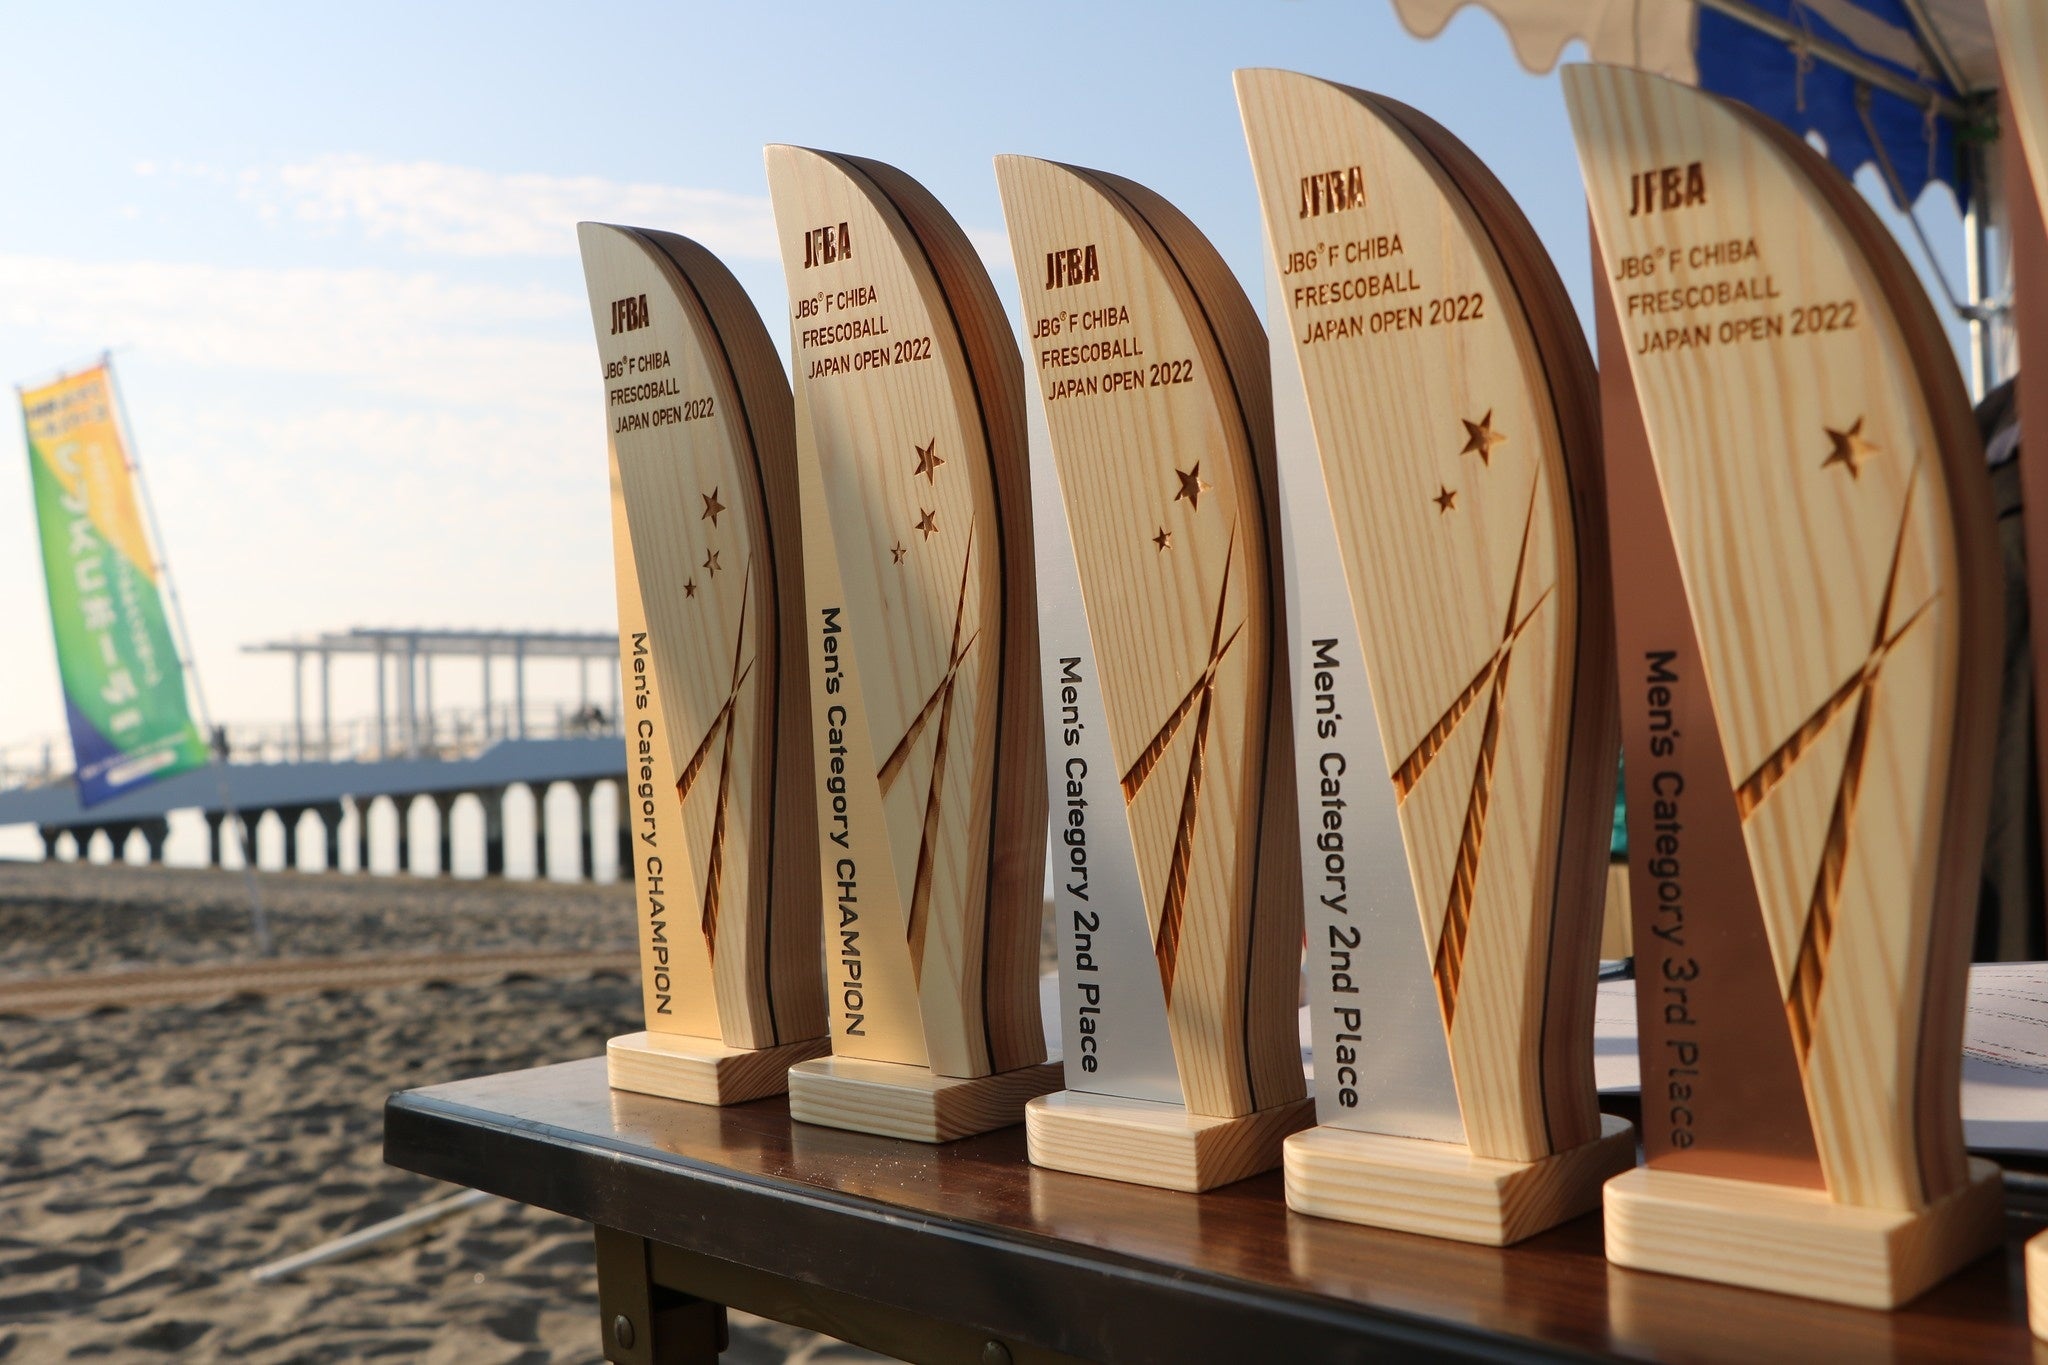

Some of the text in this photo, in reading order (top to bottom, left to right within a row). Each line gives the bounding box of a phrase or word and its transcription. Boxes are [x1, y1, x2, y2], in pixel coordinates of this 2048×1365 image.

[1300, 165, 1366, 219] JFBA
[1629, 161, 1707, 217] JFBA
[804, 221, 852, 269] JFBA
[1329, 245, 1339, 266] F
[1345, 234, 1404, 264] CHIBA
[1669, 250, 1681, 272] F
[1689, 237, 1759, 269] CHIBA
[1045, 244, 1100, 291] JFBA
[826, 296, 834, 315] F
[836, 285, 877, 310] CHIBA
[1294, 269, 1421, 310] FRESCOBALL
[1626, 275, 1780, 317] FRESCOBALL
[610, 293, 650, 335] JFBA
[802, 316, 889, 349] FRESCOBALL
[1069, 314, 1078, 333] F
[1082, 305, 1130, 331] CHIBA
[1302, 292, 1484, 344] JAPAN OPEN 2022
[1638, 301, 1858, 355] JAPAN OPEN 2022
[628, 358, 636, 375] F
[637, 350, 670, 373] CHIBA
[808, 336, 932, 380] JAPAN OPEN 2022
[1041, 337, 1144, 370] FRESCOBALL
[610, 377, 680, 407] FRESCOBALL
[1048, 359, 1193, 401] JAPAN OPEN 2022
[615, 397, 714, 434] JAPAN OPEN 2022
[631, 631, 672, 1015] Men's Category CHAMPION
[821, 606, 866, 1037] Men's Category CHAMPION
[1059, 656, 1101, 1073] Men's Category 2nd Place
[1311, 638, 1362, 1109] Men's Category 2nd Place
[1645, 650, 1699, 1150] Men's Category 3rd Place
